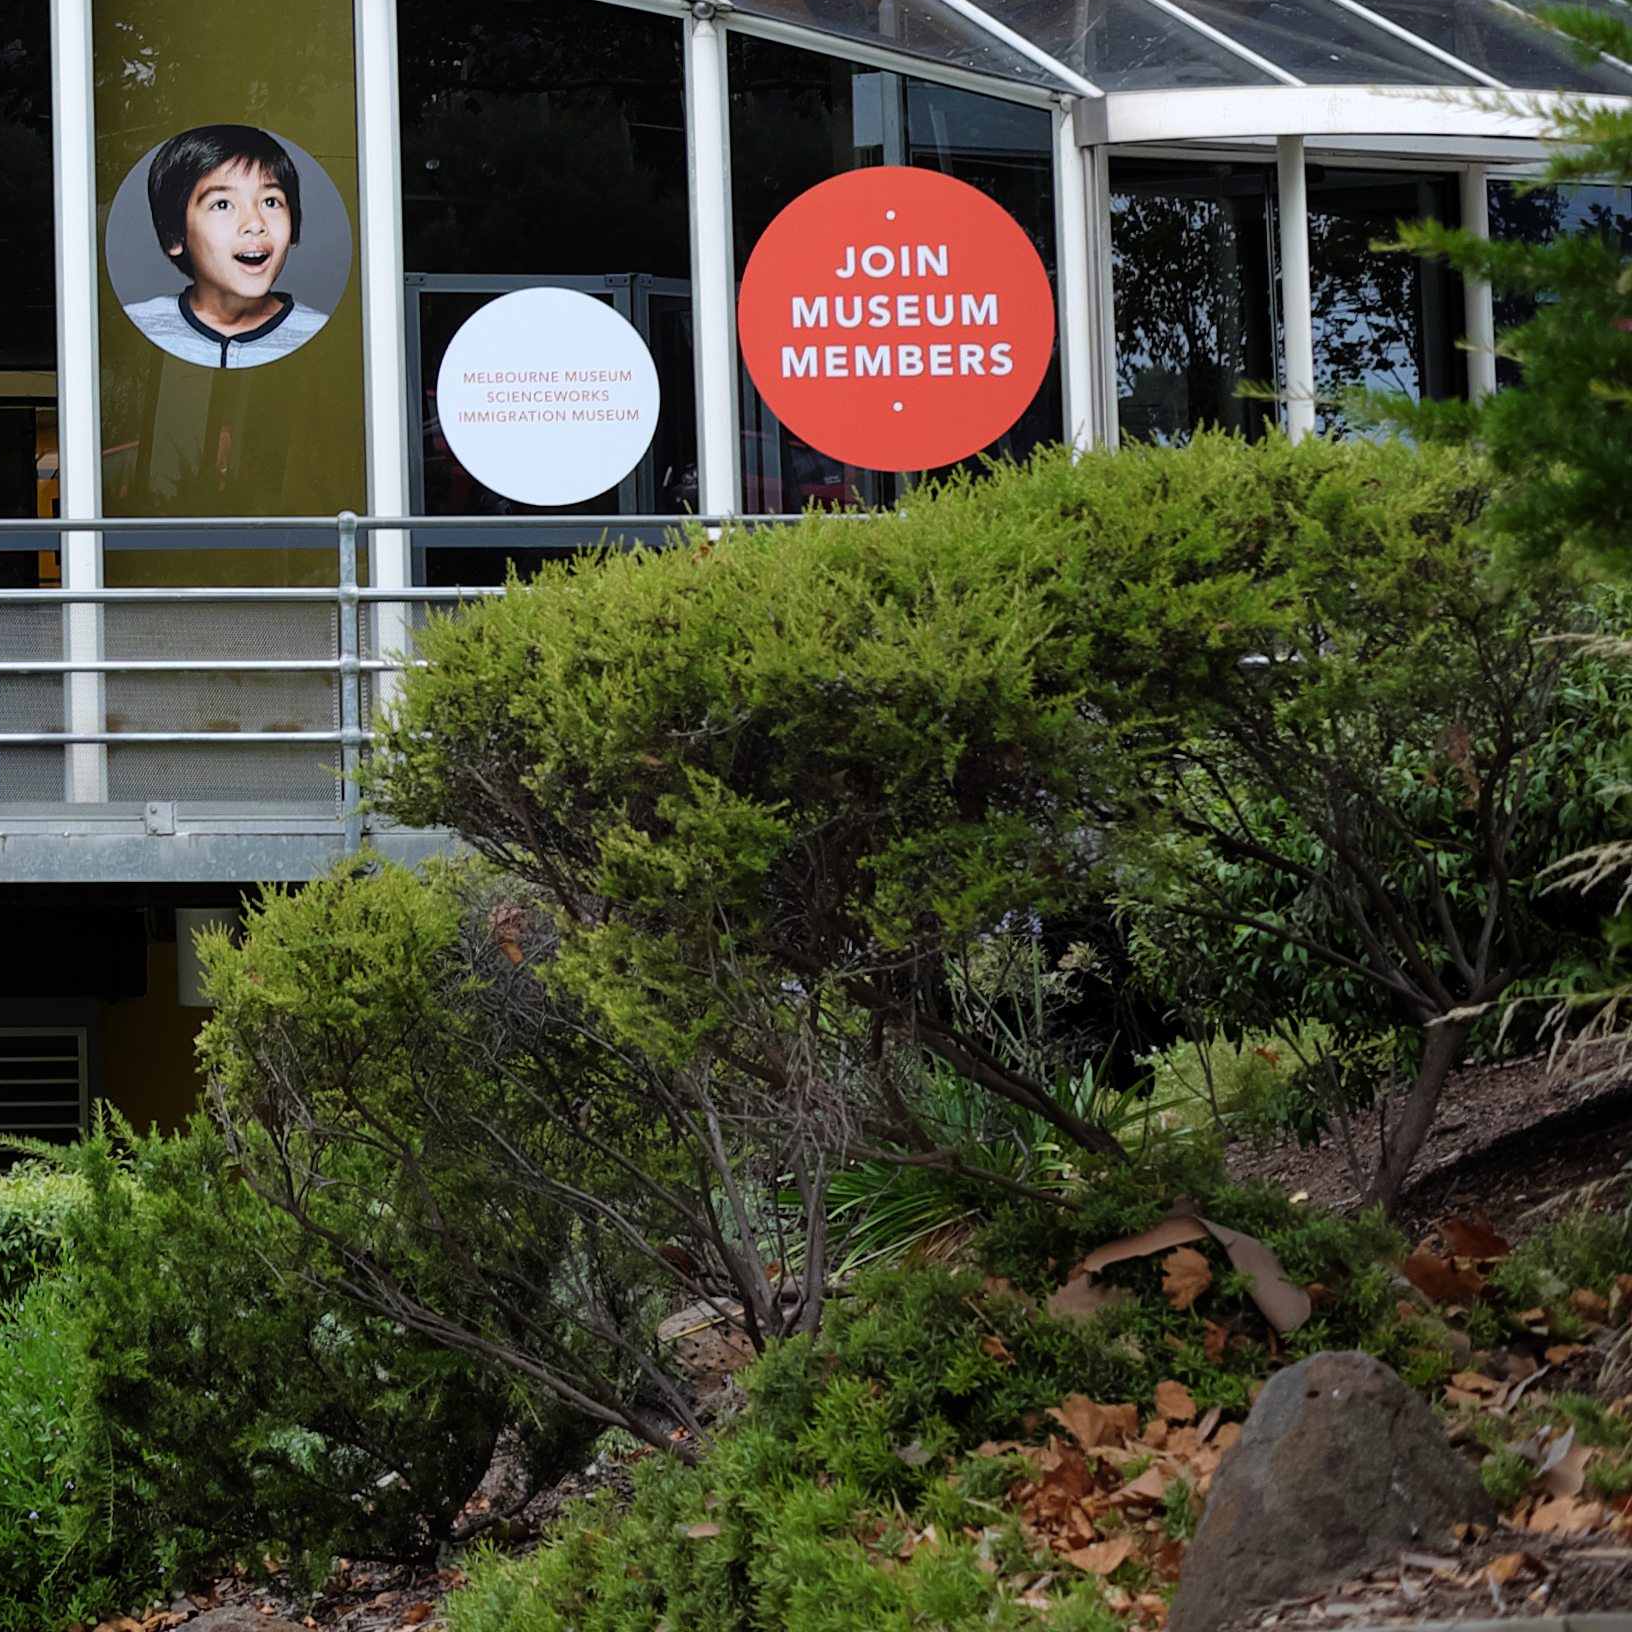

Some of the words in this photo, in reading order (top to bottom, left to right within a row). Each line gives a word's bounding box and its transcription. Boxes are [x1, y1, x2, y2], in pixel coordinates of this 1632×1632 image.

[835, 244, 948, 279] JOIN
[791, 293, 998, 328] MUSEUM
[781, 342, 1014, 378] MEMBERS
[463, 371, 559, 384] MELBOURNE
[564, 369, 632, 383] MUSEUM
[486, 390, 610, 404] SCIENCEWORKS
[458, 410, 566, 423] IMMIGRATION
[572, 409, 639, 422] MUSEUM
